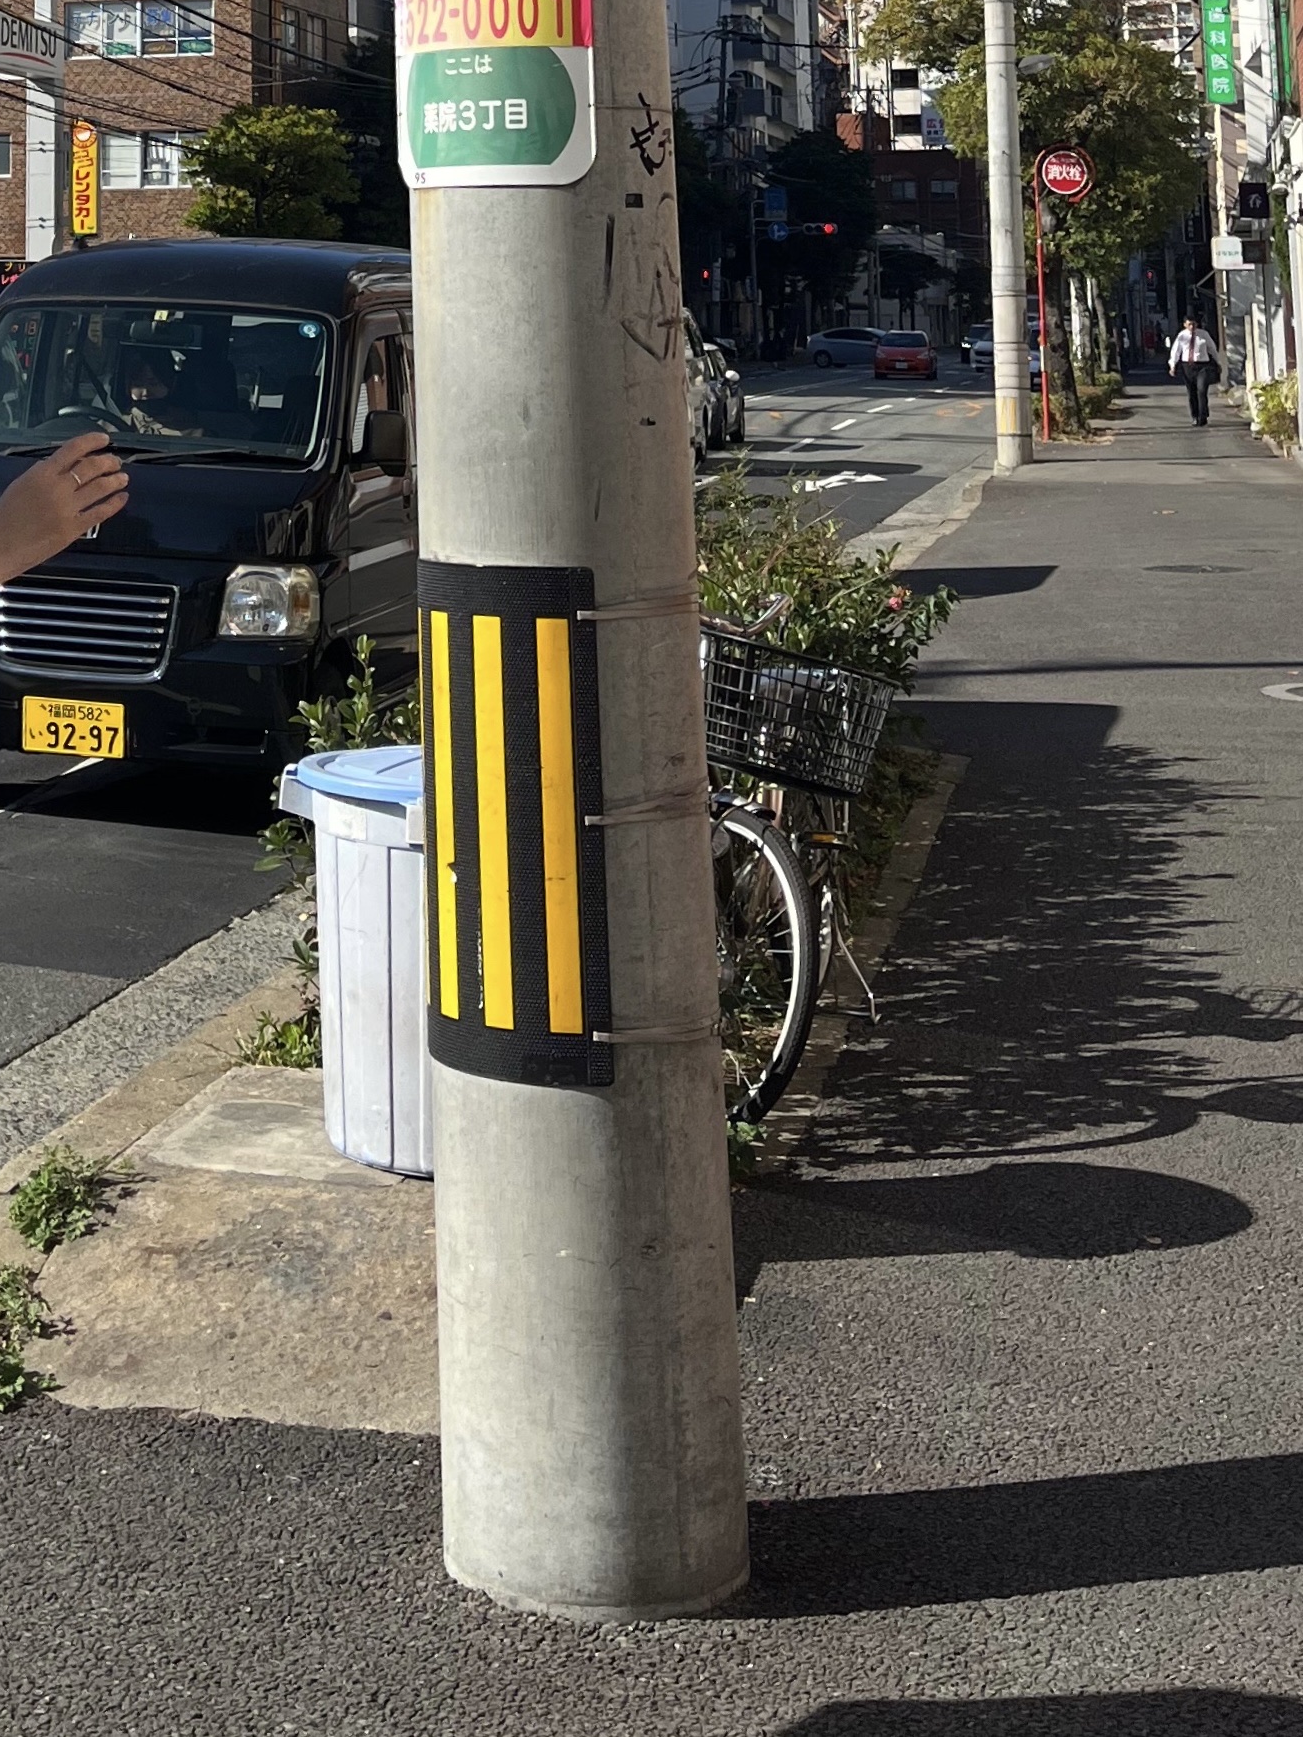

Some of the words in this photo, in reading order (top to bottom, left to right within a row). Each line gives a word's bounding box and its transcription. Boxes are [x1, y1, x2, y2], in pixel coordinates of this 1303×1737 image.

[445, 54, 492, 75] ここは
[423, 98, 528, 134] 薬院3丁目
[1047, 164, 1082, 181] 消火栓
[75, 169, 91, 231] レンタカー
[48, 704, 76, 719] 福岡
[78, 705, 103, 722] 582
[29, 727, 43, 740] い
[46, 722, 119, 754] 92-97
